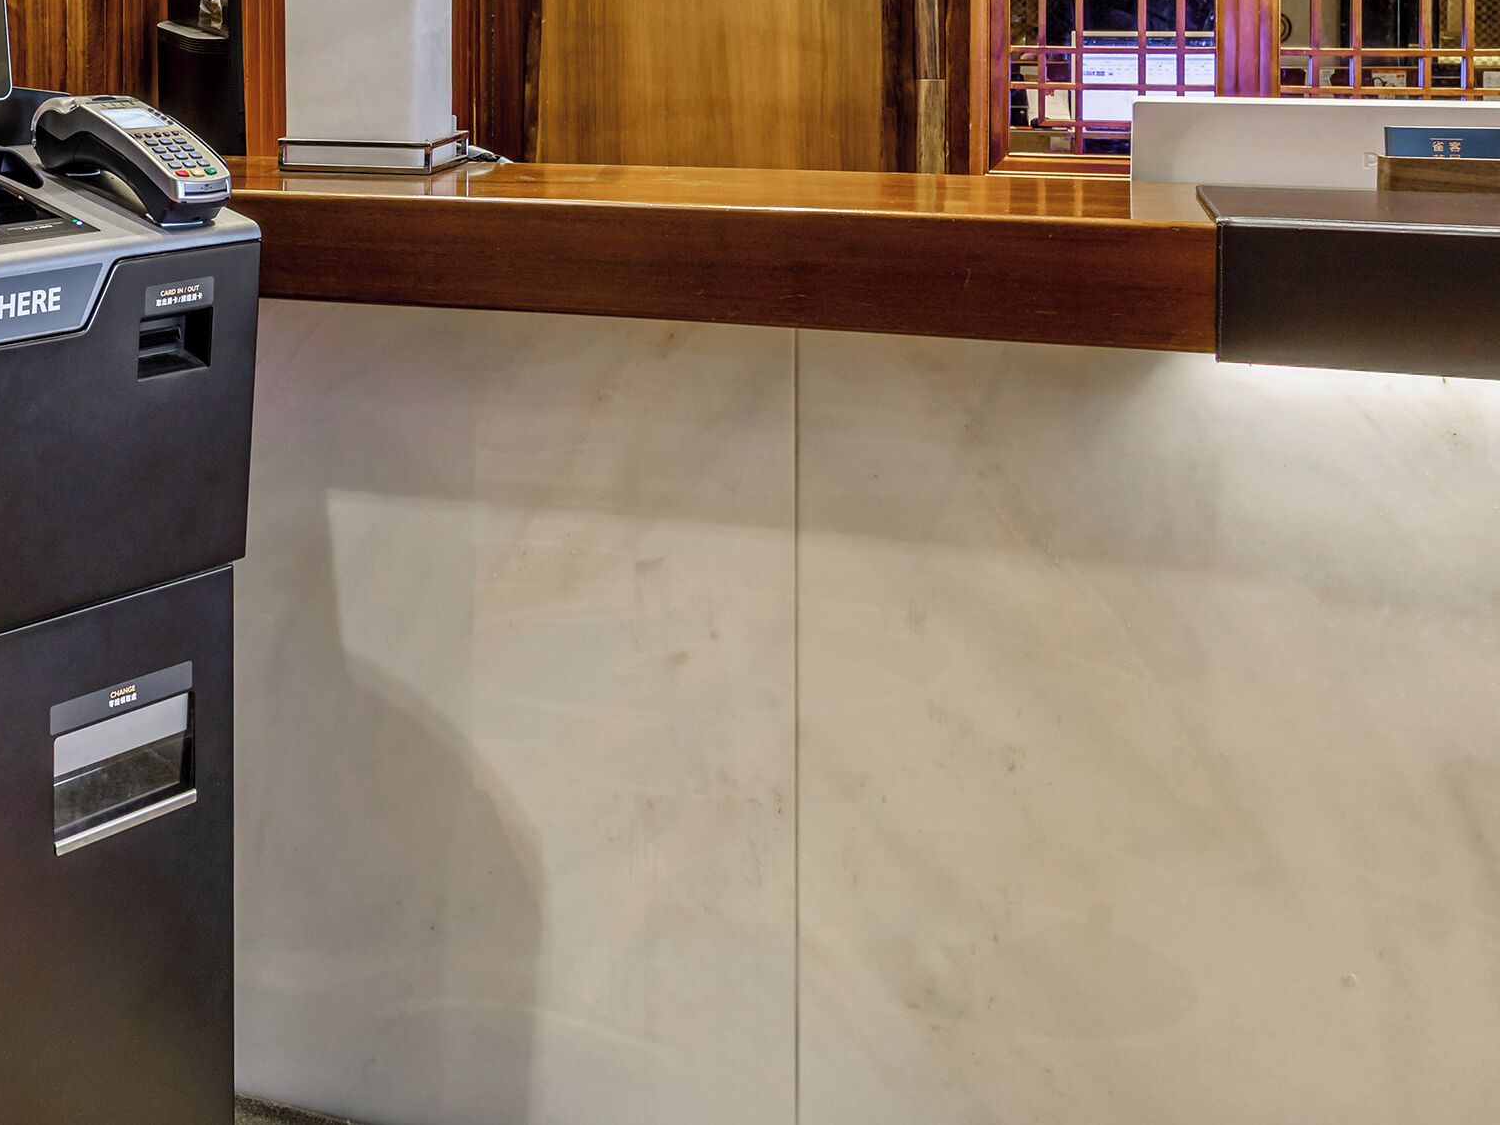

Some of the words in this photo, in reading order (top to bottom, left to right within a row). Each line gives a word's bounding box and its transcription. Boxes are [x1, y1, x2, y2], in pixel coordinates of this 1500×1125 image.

[160, 288, 176, 297] CARD
[187, 284, 200, 293] OUT
[110, 684, 136, 699] CHANGE
